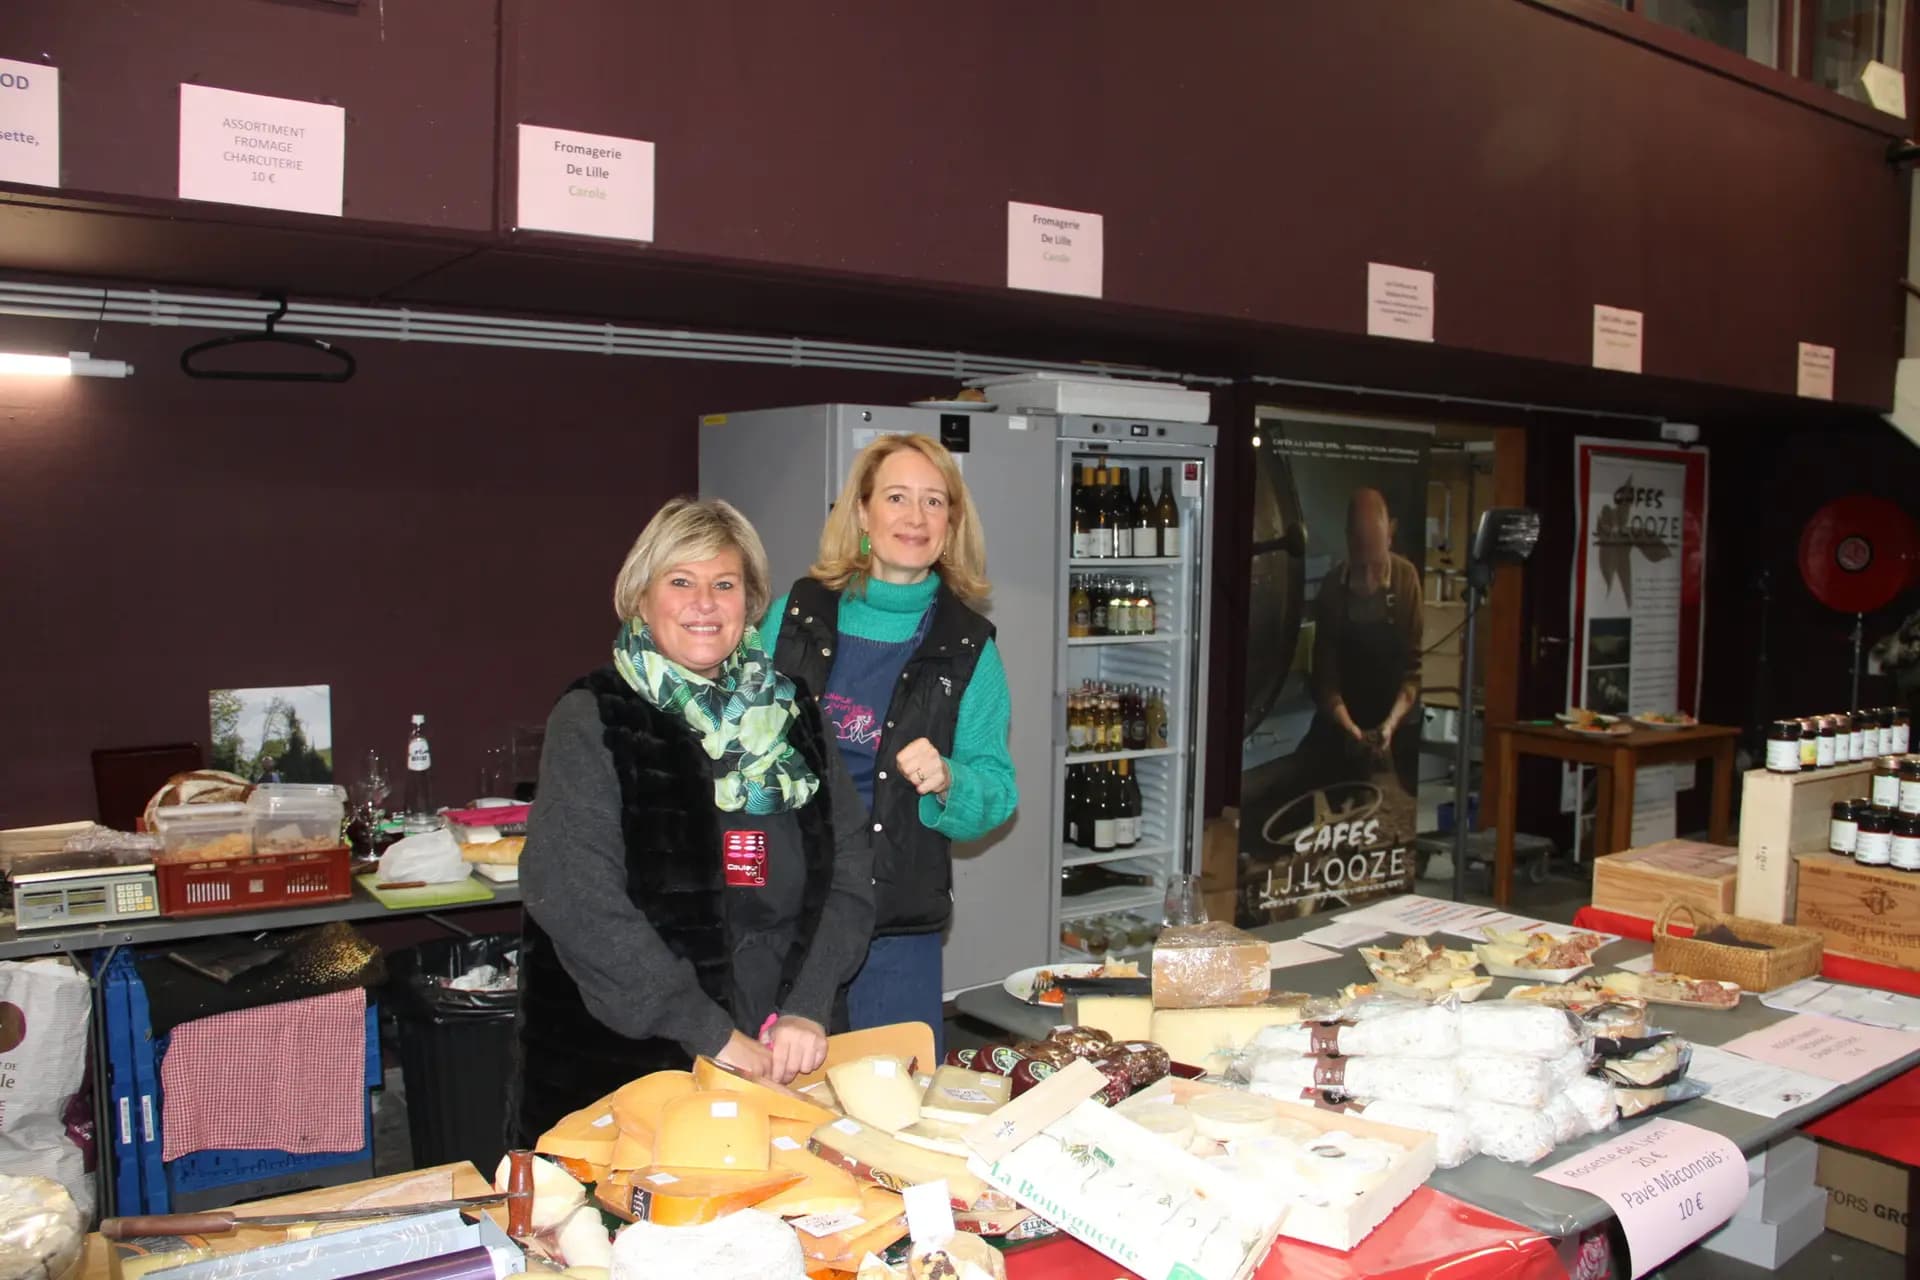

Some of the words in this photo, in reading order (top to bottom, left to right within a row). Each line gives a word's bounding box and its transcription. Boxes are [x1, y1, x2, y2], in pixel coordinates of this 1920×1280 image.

[223, 118, 304, 138] ASSORTIMENT
[234, 136, 293, 152] FROMAGE
[554, 141, 622, 160] Fromagerie
[223, 151, 304, 171] CHARCUTERIE
[251, 171, 265, 182] 10
[268, 173, 277, 184] €
[566, 164, 583, 176] De
[586, 166, 610, 179] Lille
[568, 185, 607, 200] Carole
[1032, 214, 1080, 230] Fromagerie
[1041, 233, 1053, 244] De
[1294, 819, 1379, 853] CAFES
[1564, 1152, 1618, 1178] Rosette
[1632, 1128, 1666, 1147] Lyon
[1632, 1156, 1654, 1168] 20
[990, 1159, 1012, 1186] La
[1621, 1179, 1659, 1209] Pavé
[1653, 1151, 1723, 1193] Mâconnais
[1678, 1197, 1695, 1221] 10
[1695, 1191, 1705, 1211] €
